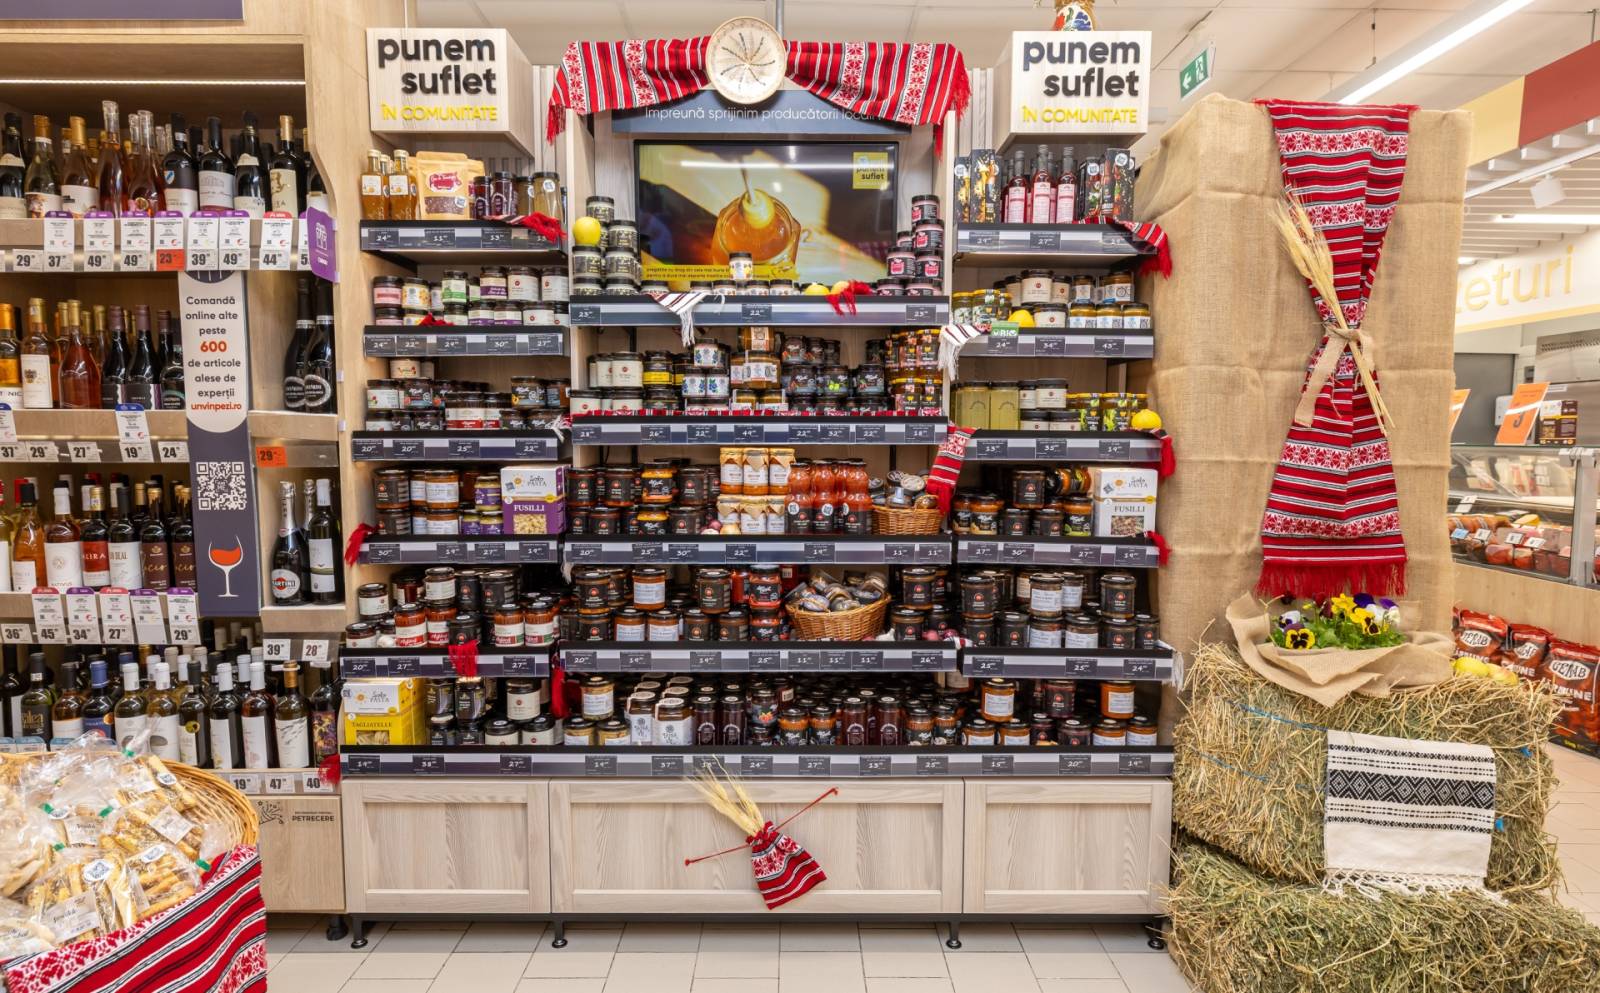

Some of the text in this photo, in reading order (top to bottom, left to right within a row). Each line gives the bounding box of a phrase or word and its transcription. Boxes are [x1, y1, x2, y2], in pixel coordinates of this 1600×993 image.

[377, 38, 496, 69] punem
[1023, 41, 1141, 72] punem
[401, 65, 496, 95] suflet
[1044, 67, 1140, 97] suflet
[381, 104, 498, 122] ÎN COMUNITATE
[1022, 106, 1138, 124] ÎN COMUNITATE
[861, 172, 884, 180] suflet
[1456, 244, 1574, 313] eturi
[186, 296, 236, 305] Comandă
[186, 311, 238, 320] online alte
[199, 327, 226, 337] peste
[200, 341, 227, 352] 600
[191, 403, 242, 412] unvinpezi.ro
